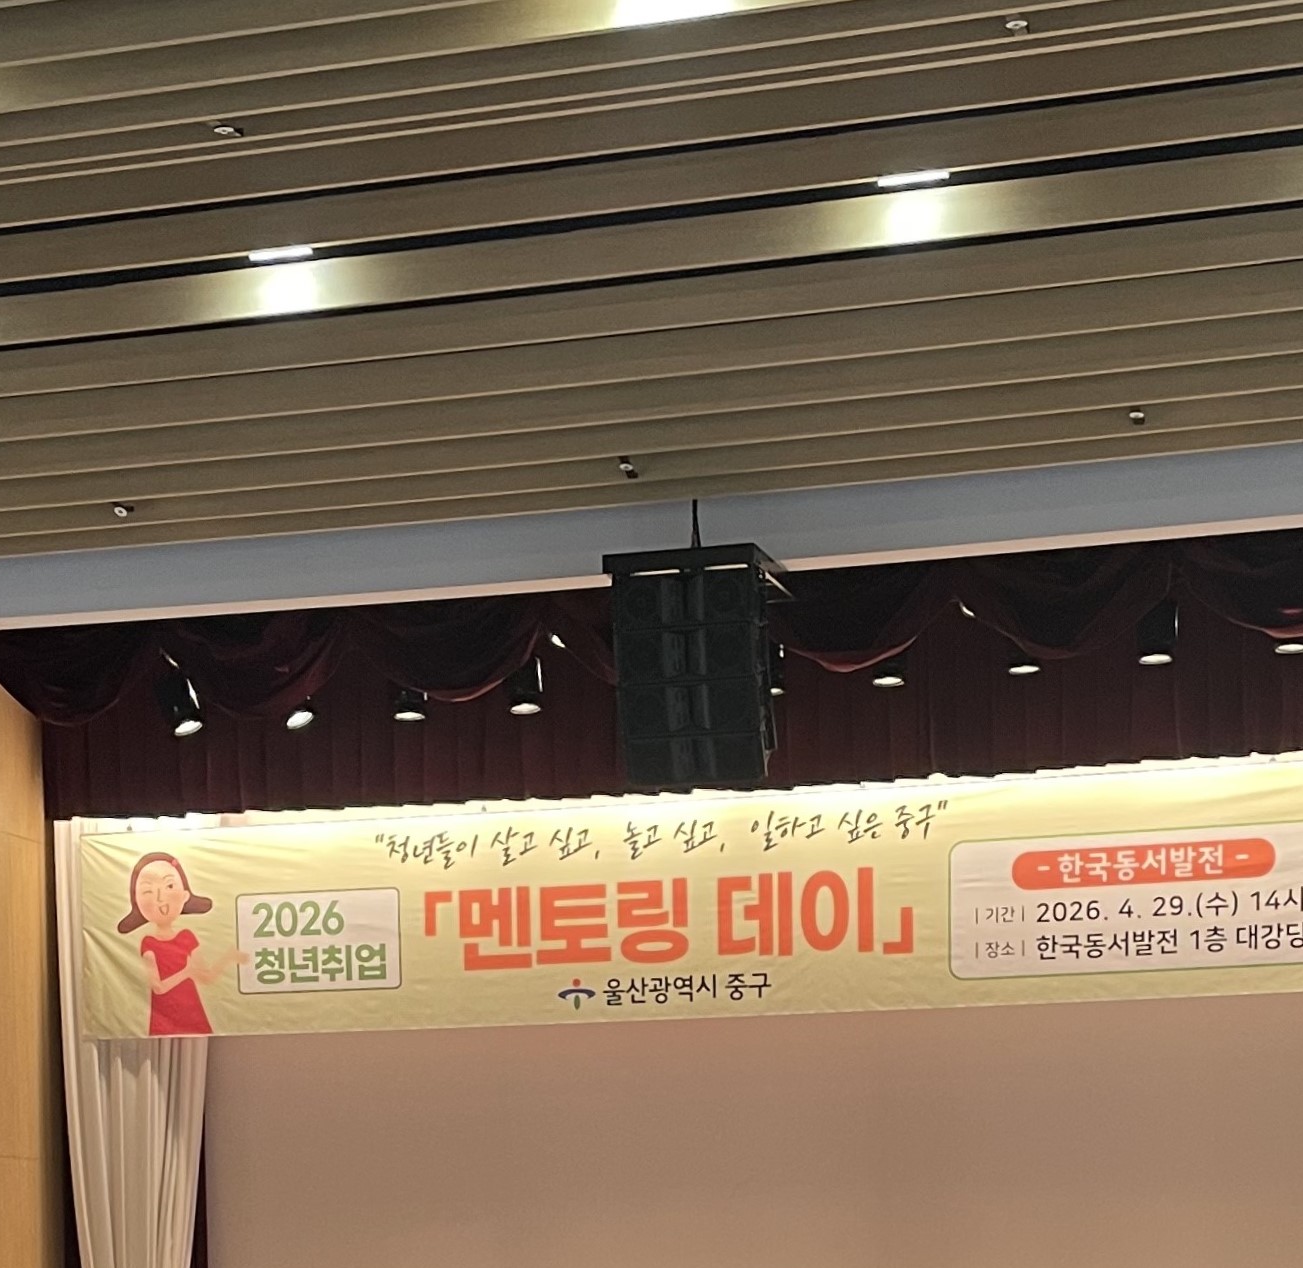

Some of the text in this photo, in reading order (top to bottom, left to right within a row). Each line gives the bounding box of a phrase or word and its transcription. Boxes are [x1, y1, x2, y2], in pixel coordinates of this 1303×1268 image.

[375, 800, 949, 870] "청년들이 살고 싶고, 놀고 싶고, 일하고 싶은 중구"
[1056, 844, 1224, 884] 한국동서발전
[252, 900, 345, 938] 2026
[424, 867, 914, 971] 「멘토링 데이」
[985, 905, 1016, 923] 기간
[1036, 900, 1109, 923] 2026.
[1118, 898, 1142, 919] 4.
[1152, 890, 1239, 919] 29.(수)
[985, 940, 1016, 959] 장소
[1036, 928, 1178, 960] 한국동서발전
[1189, 926, 1228, 953] 1층
[254, 943, 387, 985] 청년취업
[602, 973, 773, 1006] 울산광역시 중구
